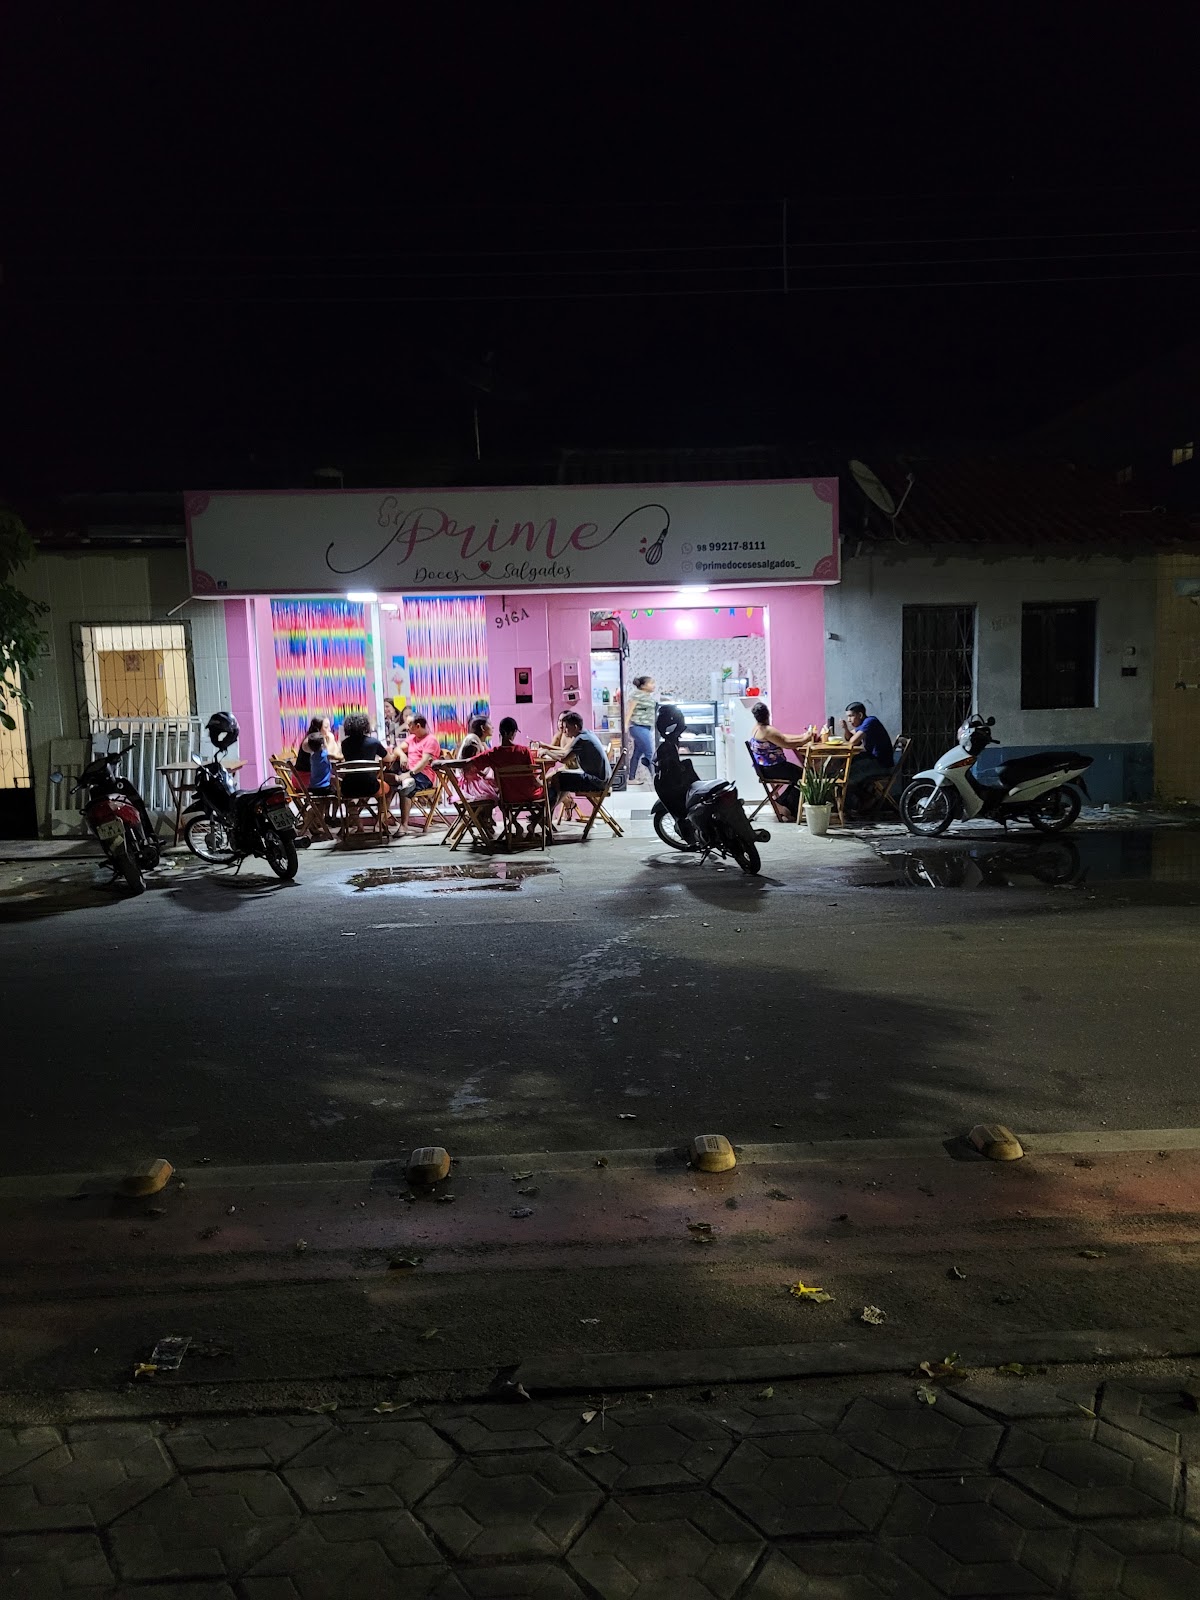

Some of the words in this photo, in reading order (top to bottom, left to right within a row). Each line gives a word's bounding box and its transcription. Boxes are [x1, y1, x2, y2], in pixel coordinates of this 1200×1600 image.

[396, 507, 599, 566] Prime
[697, 544, 707, 552] 98
[709, 541, 766, 551] 99217-8111
[413, 567, 461, 583] Doces
[503, 561, 574, 581] Salgados
[696, 558, 801, 571] @primedocesesalgados_
